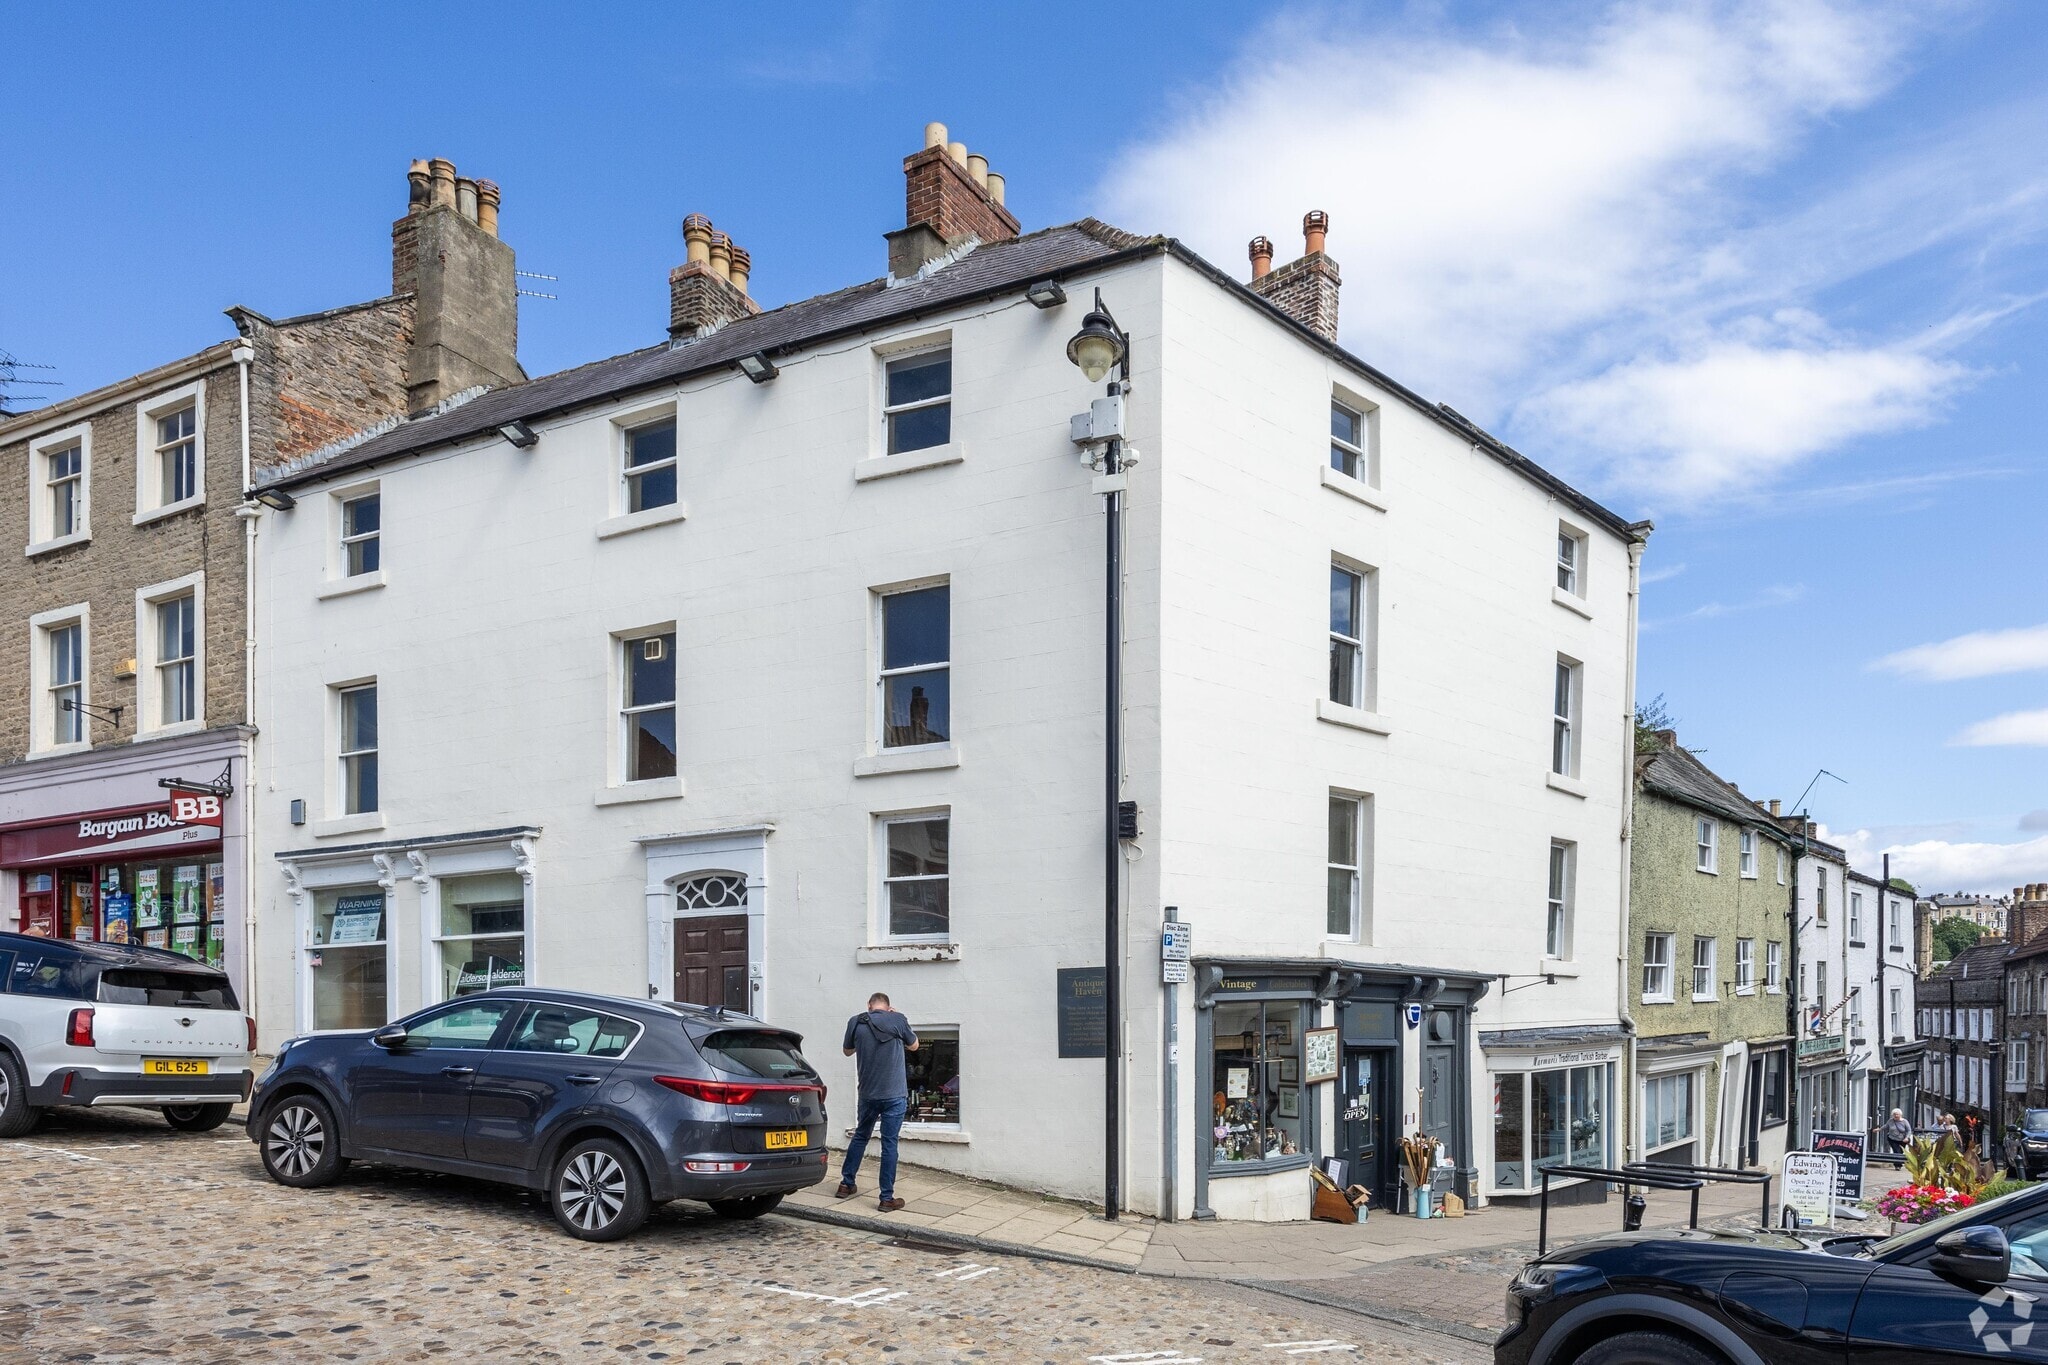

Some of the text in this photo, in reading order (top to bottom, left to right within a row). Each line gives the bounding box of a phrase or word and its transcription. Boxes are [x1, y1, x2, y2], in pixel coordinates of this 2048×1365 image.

[174, 796, 221, 821] BB
[78, 811, 186, 839] Bargain Boo
[182, 830, 199, 840] Plus
[338, 898, 383, 909] WARNING
[460, 973, 487, 983] alderso
[1071, 979, 1105, 990] Antique
[1220, 979, 1257, 991] Vintage
[1075, 987, 1102, 996] Haven
[155, 1062, 198, 1072] GIL 625
[1344, 1109, 1366, 1120] OPEN
[771, 1132, 802, 1145] LD16 AYT
[1793, 1158, 1827, 1168] Edwina's
[1838, 1156, 1860, 1165] Barber
[1810, 1168, 1828, 1176] Cakes
